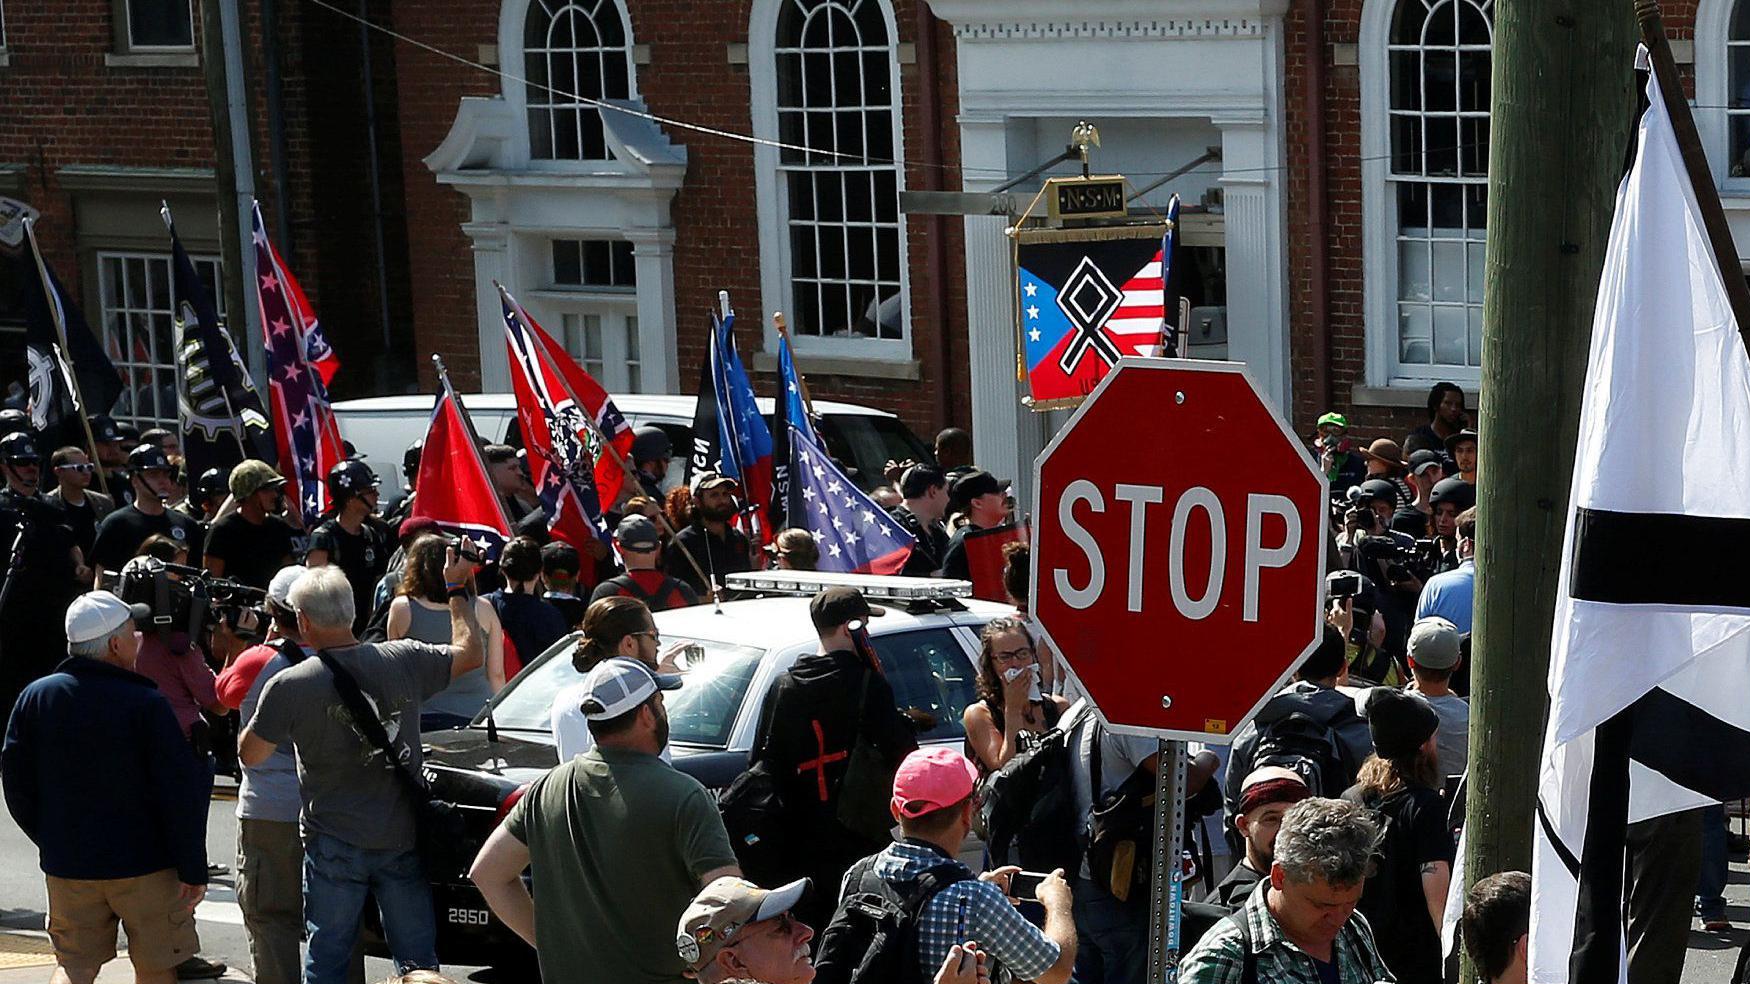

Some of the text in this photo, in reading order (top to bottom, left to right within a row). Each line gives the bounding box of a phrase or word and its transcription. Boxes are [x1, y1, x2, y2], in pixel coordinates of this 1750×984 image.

[1053, 479, 1302, 622] STOP
[448, 908, 489, 925] 2950
[1168, 885, 1177, 945] DOWNTOWN
